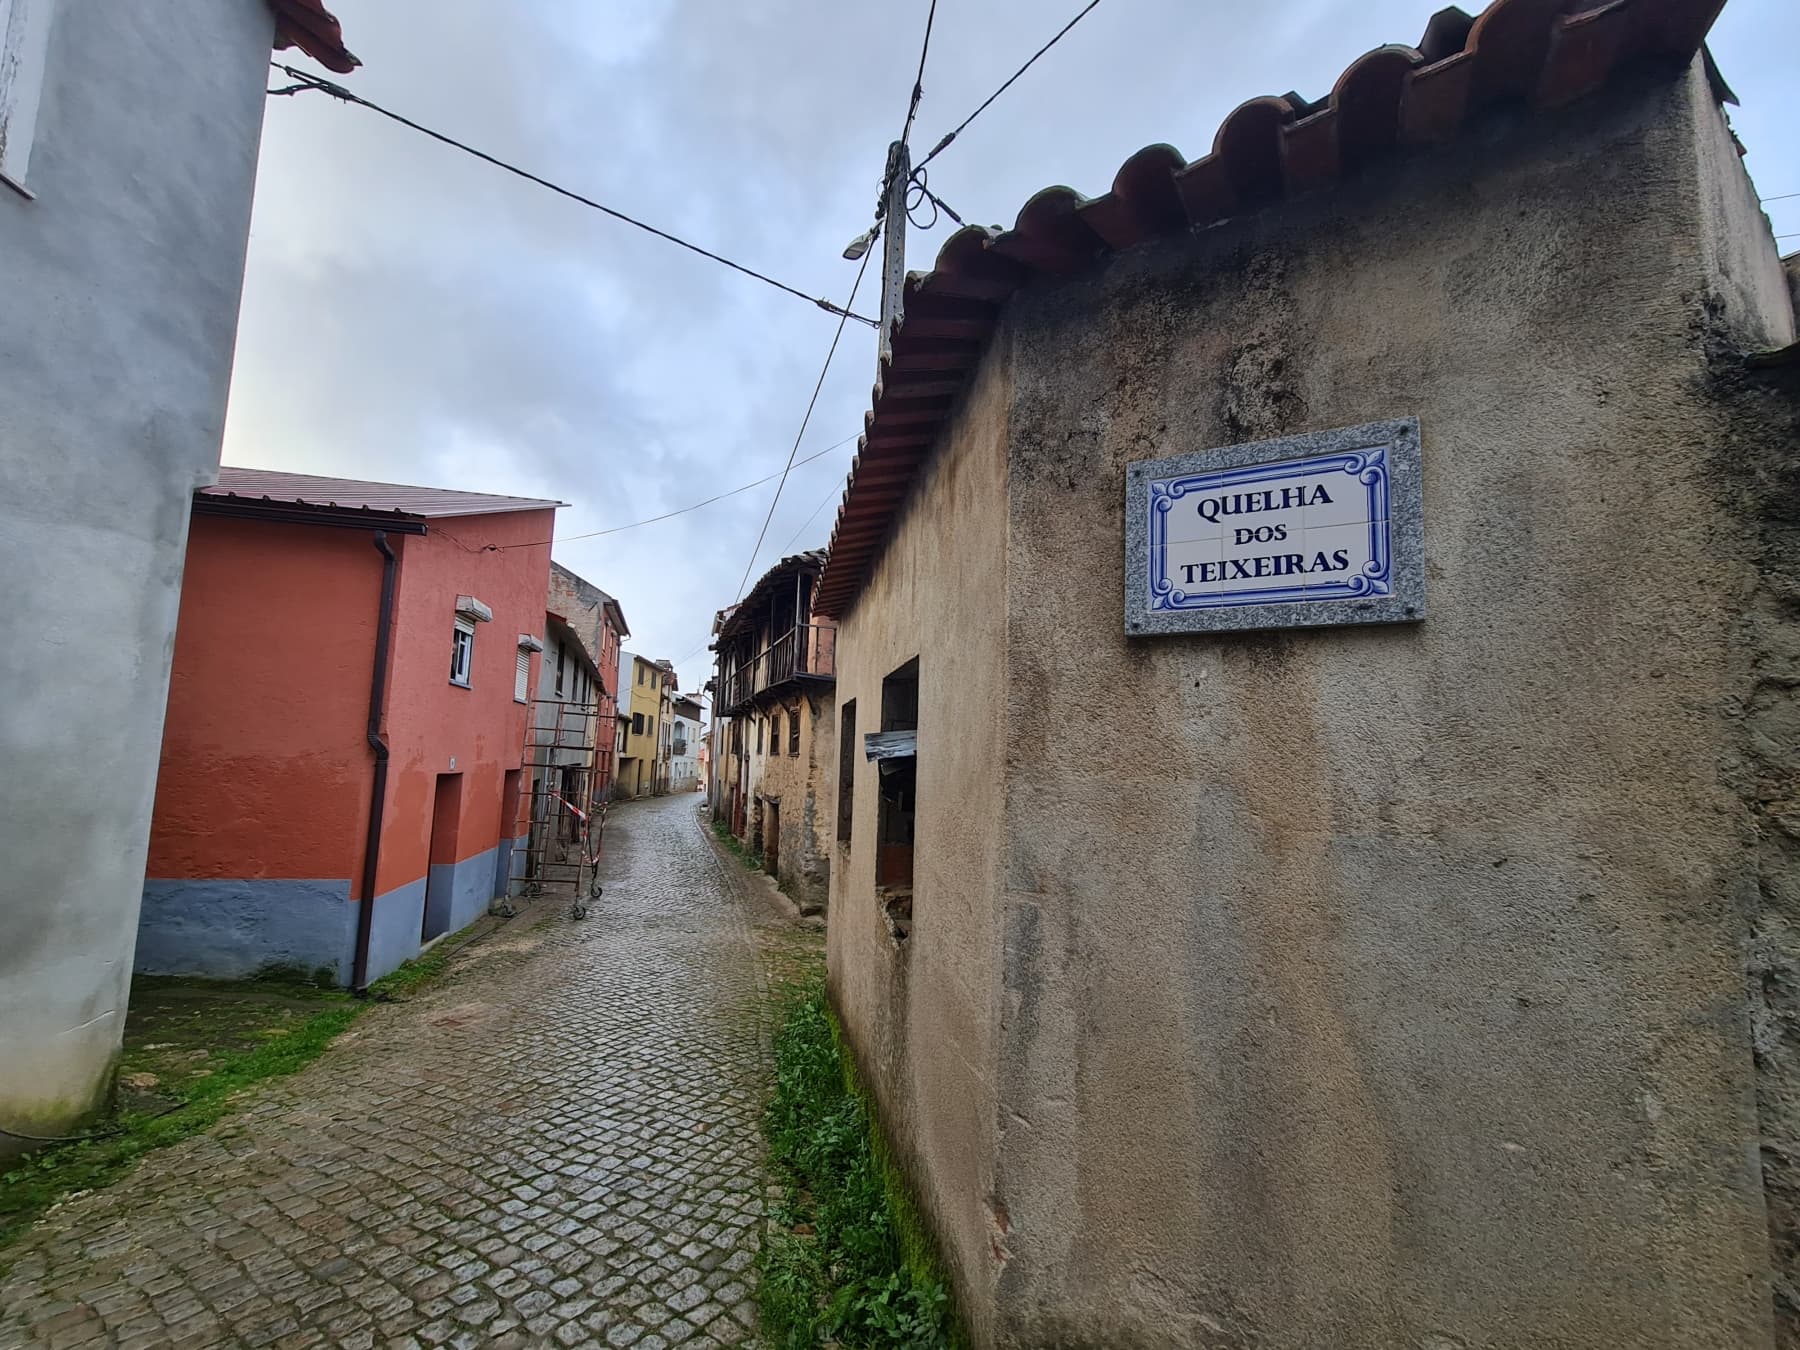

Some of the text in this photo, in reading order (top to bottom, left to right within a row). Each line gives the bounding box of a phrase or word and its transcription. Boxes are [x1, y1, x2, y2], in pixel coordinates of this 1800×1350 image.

[1197, 484, 1334, 523] QUELHA
[1234, 523, 1287, 546] DOS
[1180, 549, 1349, 584] TEIXEIRAS
